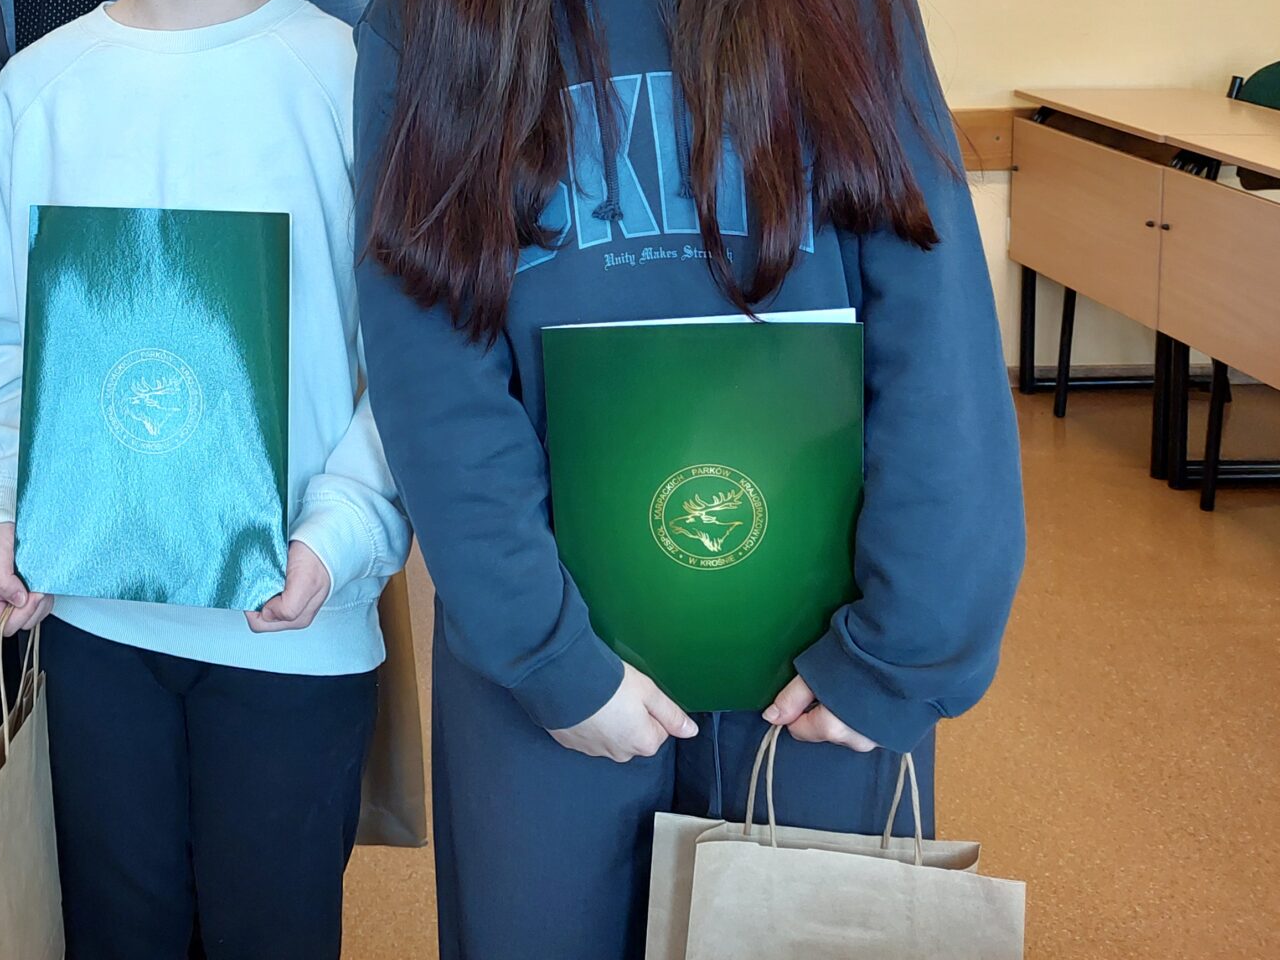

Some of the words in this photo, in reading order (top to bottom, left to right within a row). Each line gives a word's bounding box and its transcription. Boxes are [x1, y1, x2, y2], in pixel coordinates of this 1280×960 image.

[604, 252, 636, 271] Unity
[638, 246, 678, 265] Makes
[654, 474, 685, 520] KARPACKICH
[691, 467, 731, 476] PARKÓW
[738, 478, 764, 551] KRAJOBRAZOWYCH
[688, 556, 696, 566] W
[700, 556, 735, 566] KROŚNIE
